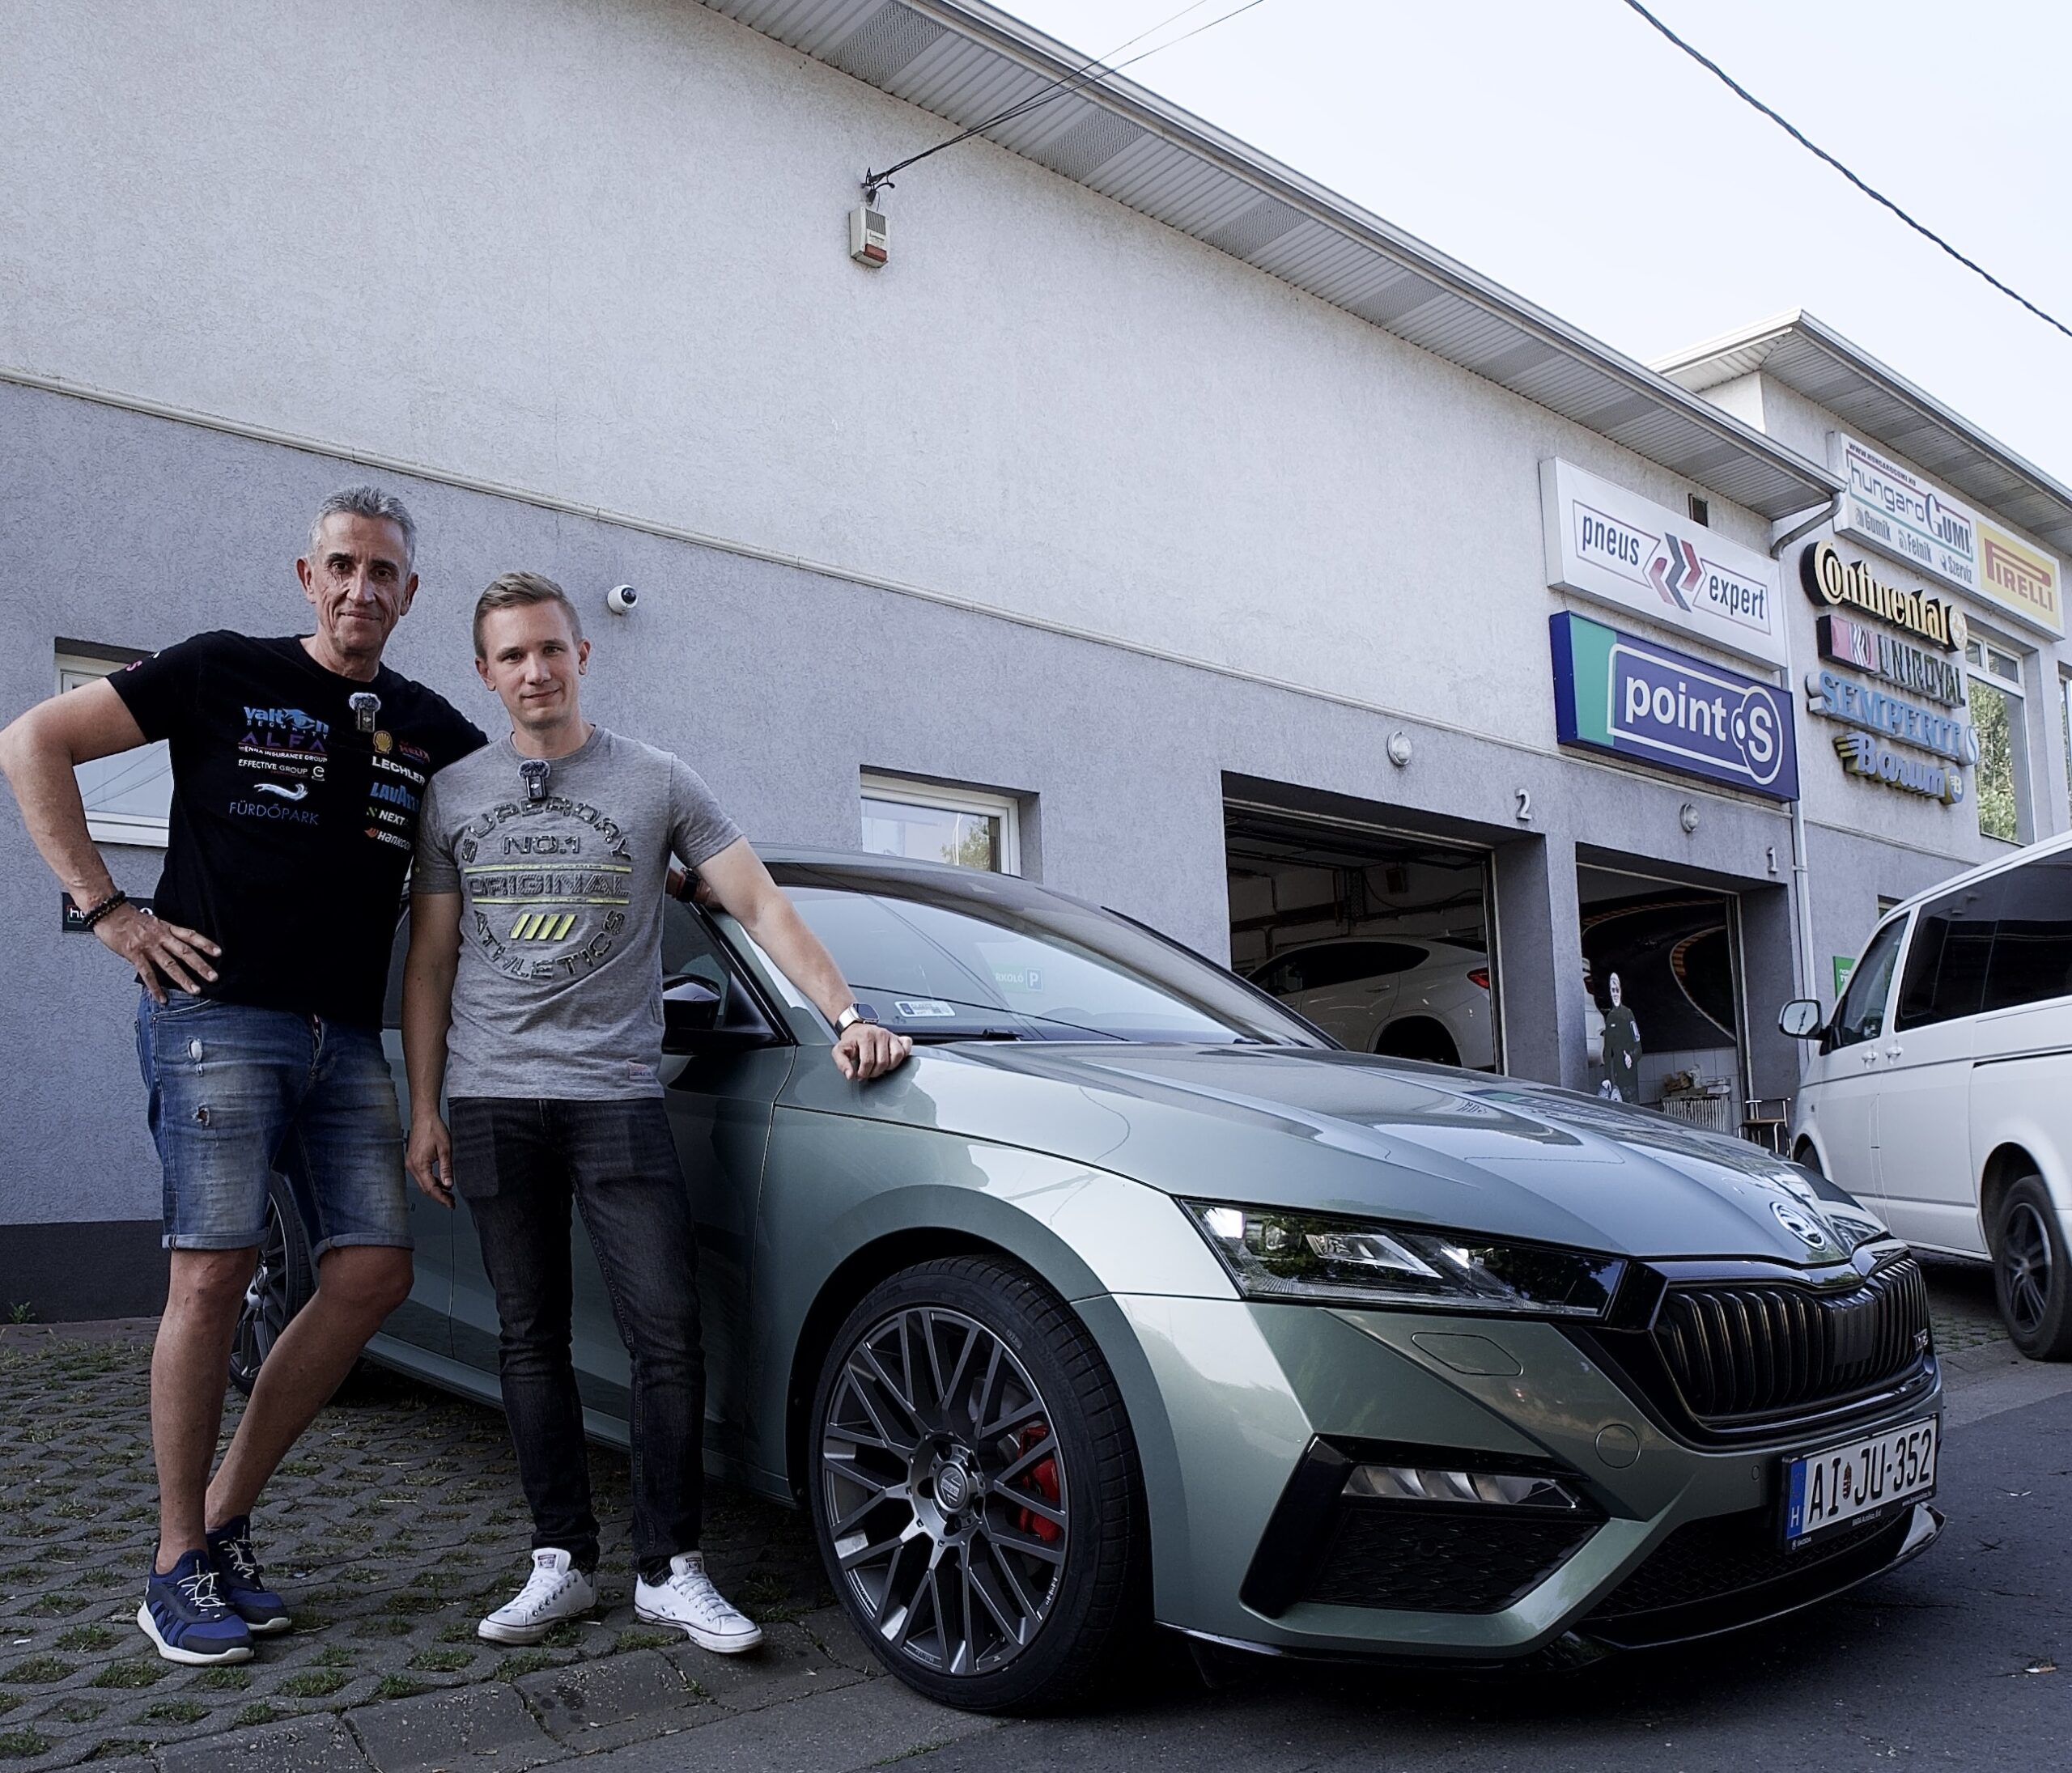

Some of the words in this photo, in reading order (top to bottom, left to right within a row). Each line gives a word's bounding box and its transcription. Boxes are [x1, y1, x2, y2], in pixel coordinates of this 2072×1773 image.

[1582, 515, 1640, 566] pneus
[1709, 575, 1764, 620] expert
[1865, 511, 1891, 542] Gumik
[1907, 532, 1932, 564] Felnik
[1948, 555, 1972, 584] Szerviz
[1984, 537, 2053, 613] PIRELLI
[1813, 539, 1950, 646] Continental
[1625, 676, 1727, 742] point
[1819, 671, 1961, 758] SEMPERIT
[238, 758, 278, 770] EFFECTIVE
[278, 765, 308, 775] GROUP
[264, 750, 304, 761] INSURANCE
[304, 754, 328, 763] GROUP
[372, 756, 426, 786] LECHLER
[1846, 731, 1946, 797] Barum
[229, 800, 319, 825] FÜRDŐPARK
[461, 796, 633, 863] SUPERDRY
[1516, 788, 1532, 821] 2
[467, 873, 630, 896] ORIGINAL
[1766, 846, 1778, 874] 1
[473, 910, 625, 978] ATHLETICS
[1790, 1505, 1801, 1529] H
